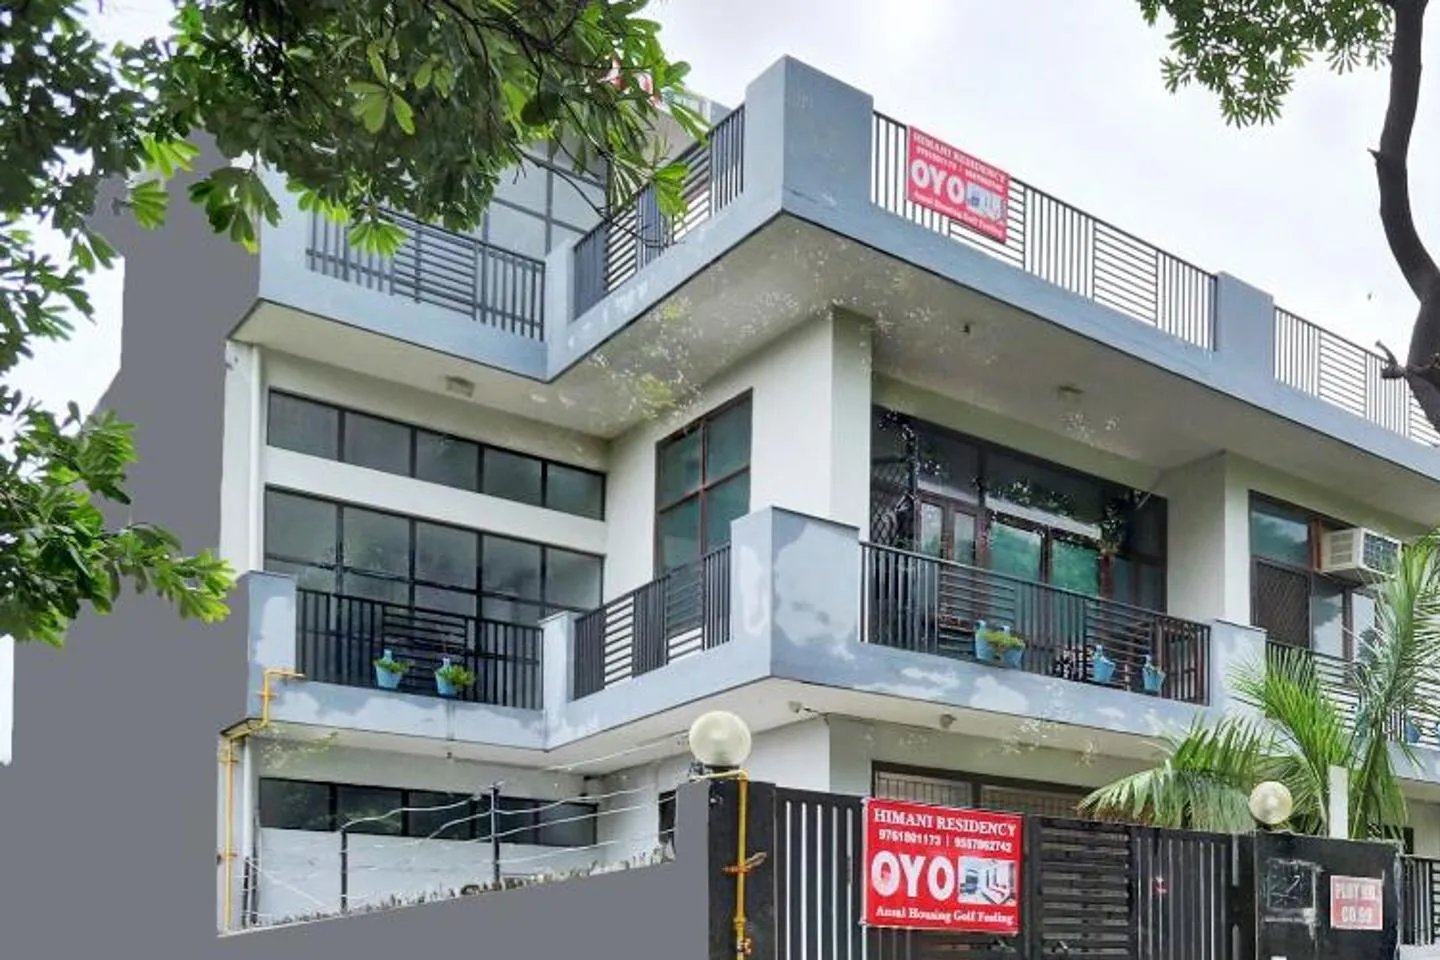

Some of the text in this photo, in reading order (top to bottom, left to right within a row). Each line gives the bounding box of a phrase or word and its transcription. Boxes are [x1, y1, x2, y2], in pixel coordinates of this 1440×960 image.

[911, 158, 965, 204] OYO
[874, 808, 1017, 836] HIMANI RESIDENCY
[871, 850, 955, 901] OYO
[909, 907, 952, 923] Housing
[953, 909, 976, 921] Golf
